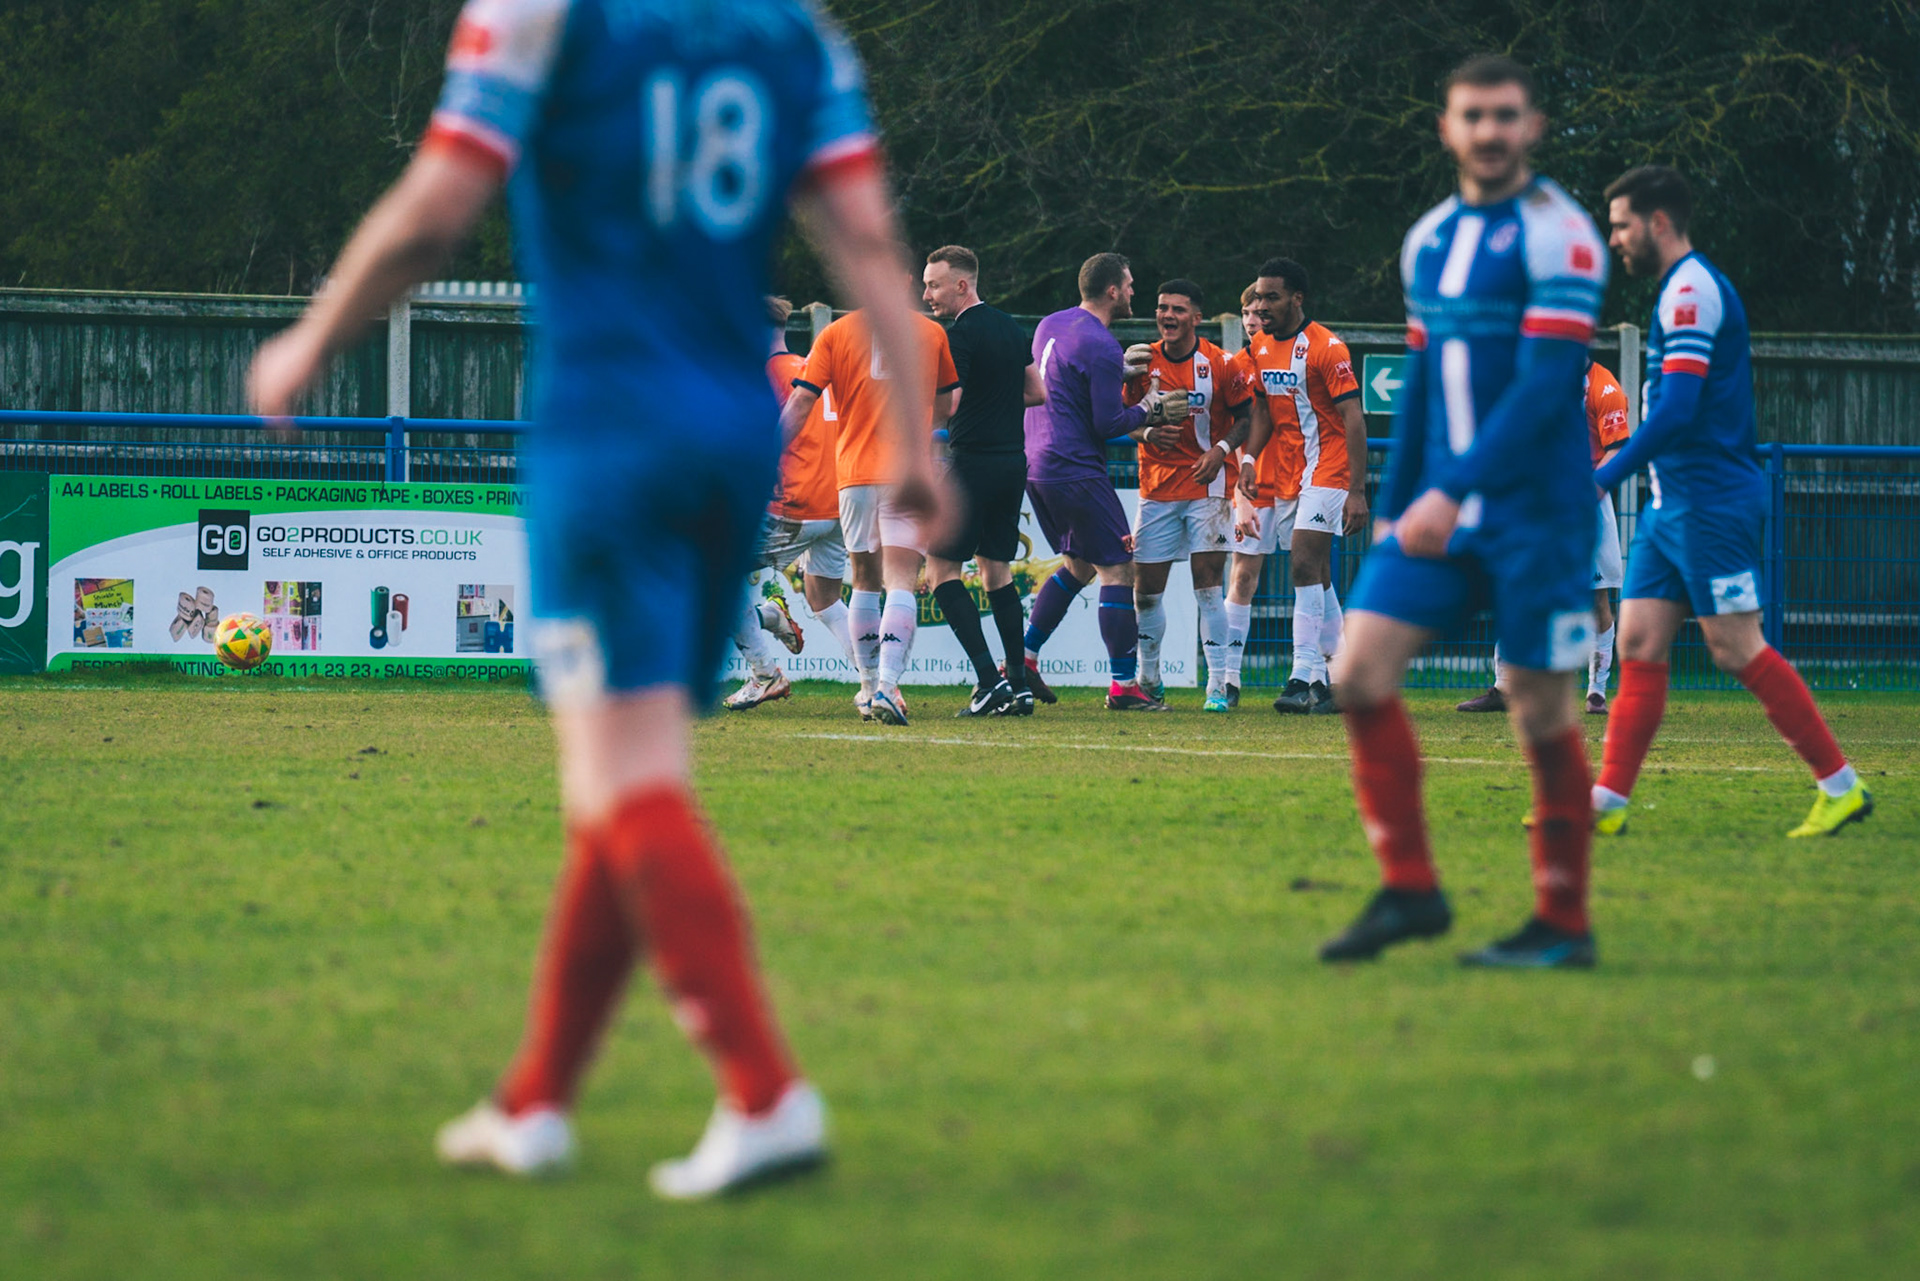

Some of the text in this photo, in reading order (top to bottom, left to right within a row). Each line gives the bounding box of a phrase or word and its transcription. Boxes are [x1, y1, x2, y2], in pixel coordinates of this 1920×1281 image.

[650, 74, 768, 230] 18
[61, 482, 84, 497] A4
[89, 483, 149, 498] LABELS
[160, 484, 200, 500] ROLL
[204, 485, 262, 501] LABELS
[275, 486, 366, 503] PACKAGING
[371, 488, 410, 503] TAPE
[423, 489, 474, 505] BOXES
[256, 526, 483, 545] GO2PRODUCTS.CO.UK
[262, 547, 476, 561] SELF ADHESIVE & OFFICE PRODUCTS
[324, 663, 345, 678] 23
[350, 664, 371, 678] 23
[925, 659, 952, 672] IP16
